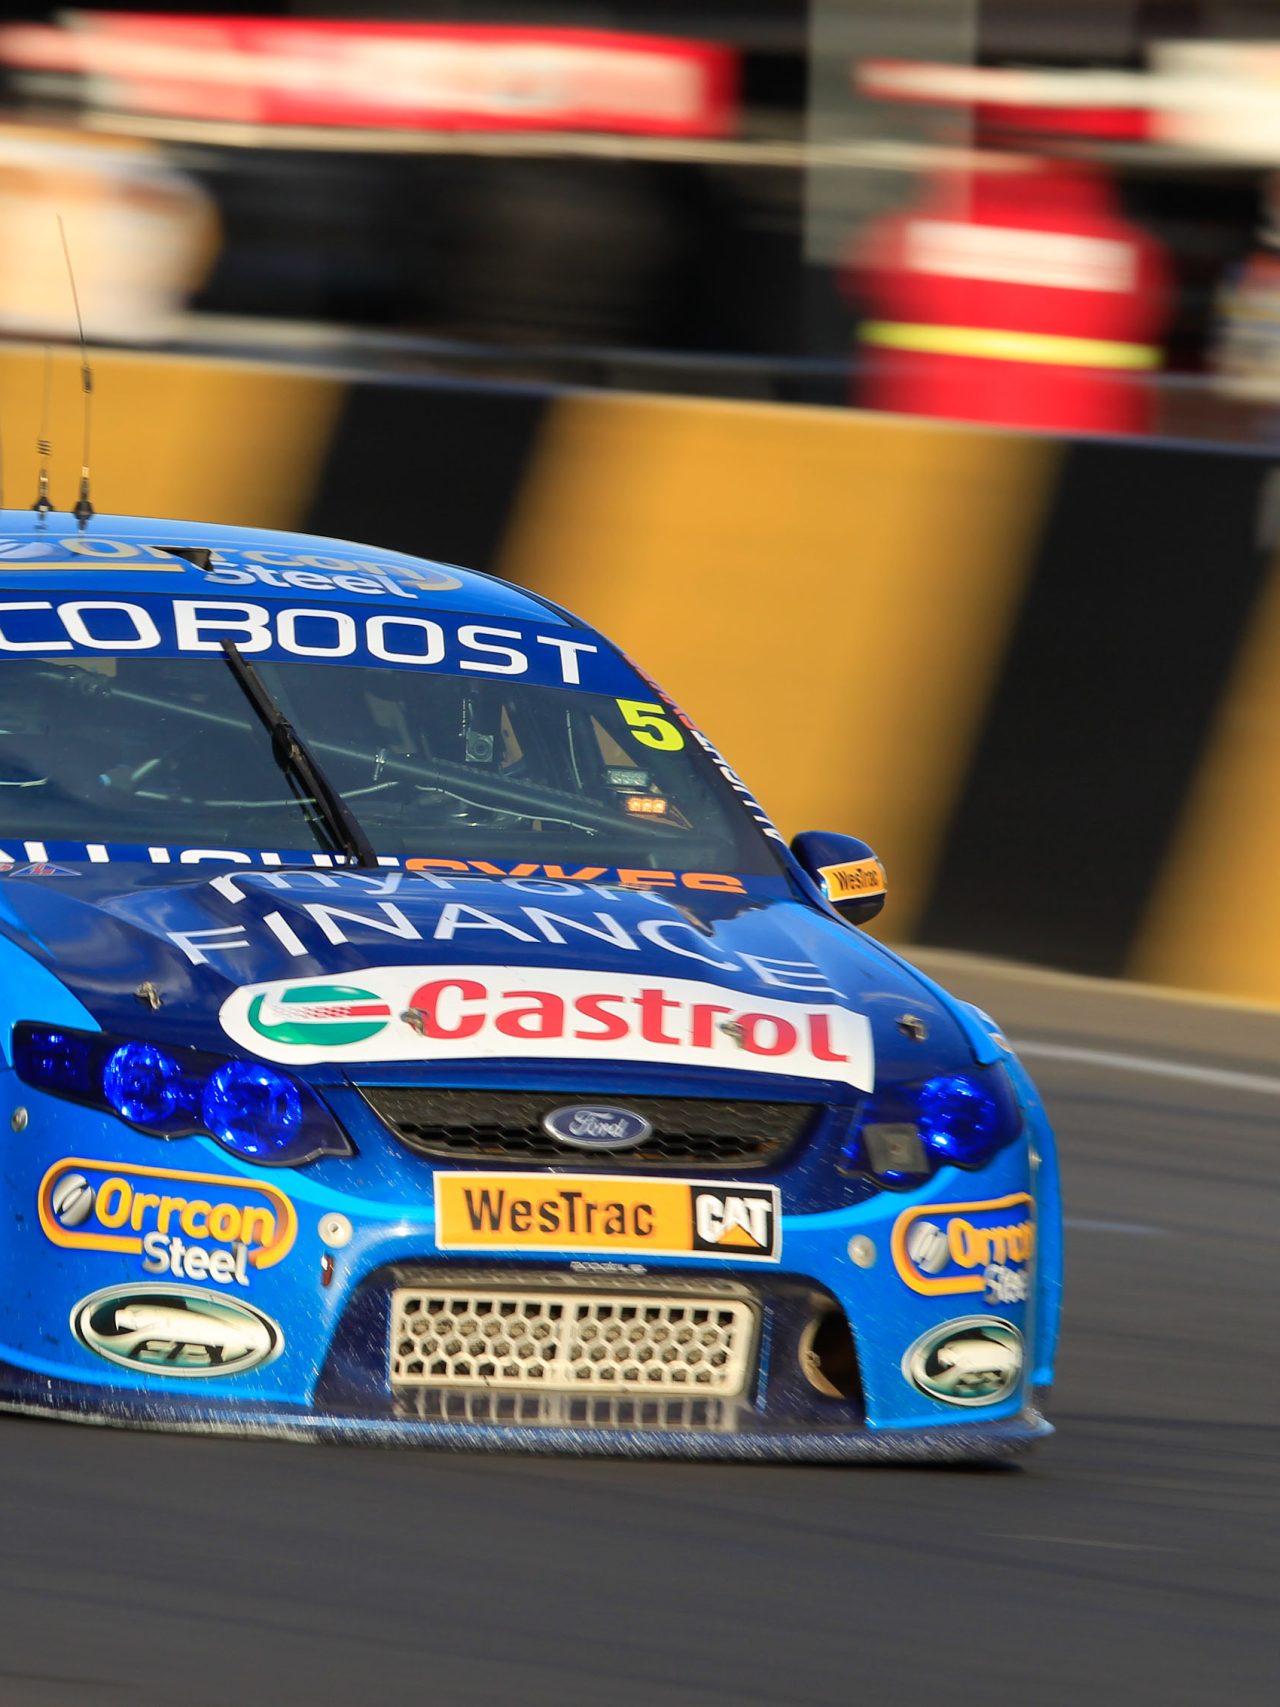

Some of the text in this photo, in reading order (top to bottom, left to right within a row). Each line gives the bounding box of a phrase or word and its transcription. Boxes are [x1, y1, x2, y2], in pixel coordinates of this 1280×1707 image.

[59, 538, 426, 587] Orcon
[203, 561, 418, 599] Steel
[616, 698, 685, 751] 5
[166, 901, 848, 999] FINANCE
[410, 979, 849, 1063] Castrol
[570, 1110, 629, 1138] Ford
[95, 1178, 276, 1248] Orrcon
[464, 1188, 773, 1248] WesTrac CAT
[141, 1231, 251, 1286] Steel
[947, 1217, 1033, 1269] Orrco
